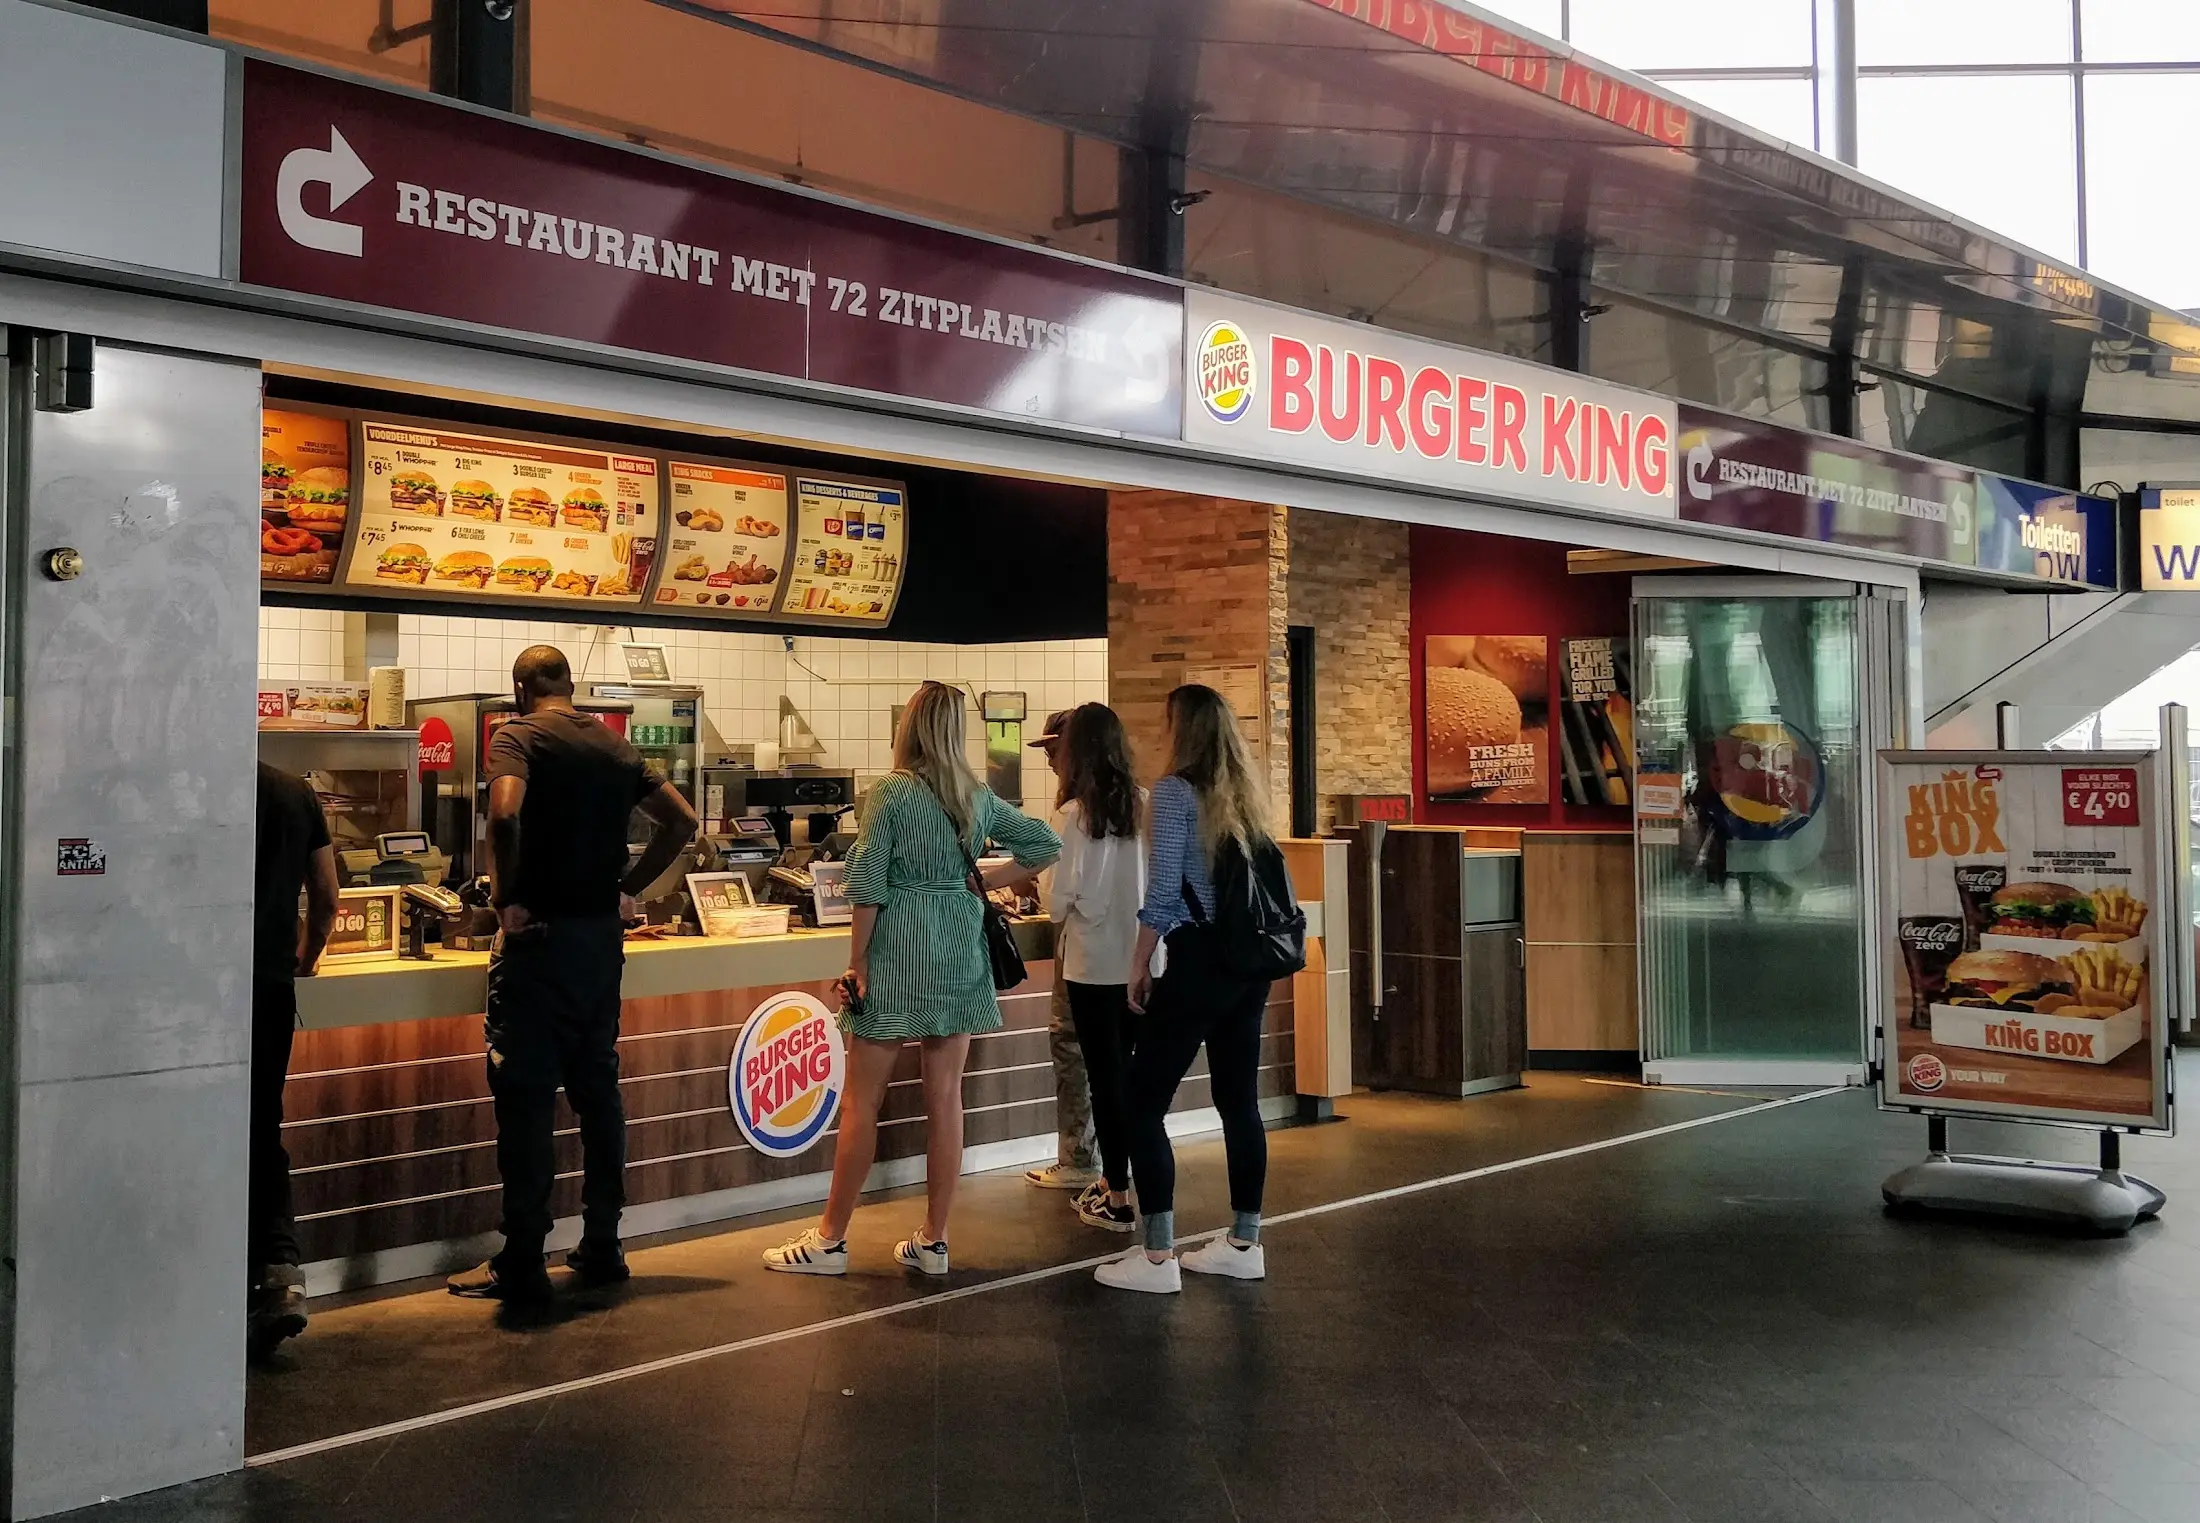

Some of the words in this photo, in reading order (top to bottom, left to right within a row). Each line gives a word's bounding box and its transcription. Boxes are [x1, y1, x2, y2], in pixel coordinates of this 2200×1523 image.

[396, 181, 719, 286] RESTAURANT
[731, 255, 816, 305] MET
[827, 278, 868, 317] 72
[879, 287, 1107, 362] ZITPLAATSEN
[1203, 344, 1247, 372] BURGER
[1204, 362, 1249, 398] KING
[1268, 333, 1528, 475] BURGER
[1540, 392, 1669, 497] KING
[369, 428, 439, 447] VOORDEELMENU'S
[396, 450, 401, 462] 1
[455, 458, 461, 469] 2
[513, 464, 519, 475] 3
[614, 461, 636, 472] LARGE
[635, 464, 654, 473] MEAL
[568, 471, 574, 482] 4
[1719, 458, 1815, 497] RESTAURANT
[1818, 478, 1846, 502] MET
[1851, 486, 1864, 506] 72
[1866, 489, 1948, 522] ZITPLAATSEN
[2165, 497, 2195, 506] toilet
[391, 521, 397, 532] 5
[451, 527, 458, 538] 6
[361, 531, 386, 545] €745
[509, 532, 515, 543] 7
[2018, 514, 2081, 555] Toiletten
[564, 537, 570, 548] 8
[627, 658, 638, 668] TO
[638, 658, 650, 668] GO
[1570, 650, 1613, 668] FLAME
[1571, 666, 1615, 682] GRILLED
[1572, 680, 1593, 694] FOR
[1594, 679, 1616, 692] YOU
[1468, 743, 1535, 759] FRESH
[1469, 758, 1501, 769] BUNS
[1503, 757, 1535, 767] FROM
[1470, 768, 1482, 781] A
[1484, 766, 1535, 780] FAMILY
[1471, 780, 1501, 788] OWNED
[1908, 780, 1999, 815] KING
[2068, 791, 2131, 819] €490
[1360, 798, 1406, 820] TRAYS
[1905, 811, 2006, 858] BOX
[60, 845, 103, 860] FC
[59, 859, 103, 870] ANTIFA
[820, 884, 832, 898] TO
[700, 896, 714, 908] TO
[714, 894, 729, 907] GO
[332, 915, 345, 933] O
[346, 914, 365, 932] GO
[1901, 921, 1960, 942] Coca-Cola
[1915, 941, 1945, 951] zero
[1985, 1024, 2040, 1052] KING
[2044, 1030, 2095, 1058] BOX
[746, 1018, 825, 1089] BURGER
[1912, 1062, 1940, 1072] BURGER
[1914, 1068, 1942, 1081] KING
[751, 1043, 831, 1127] KING
